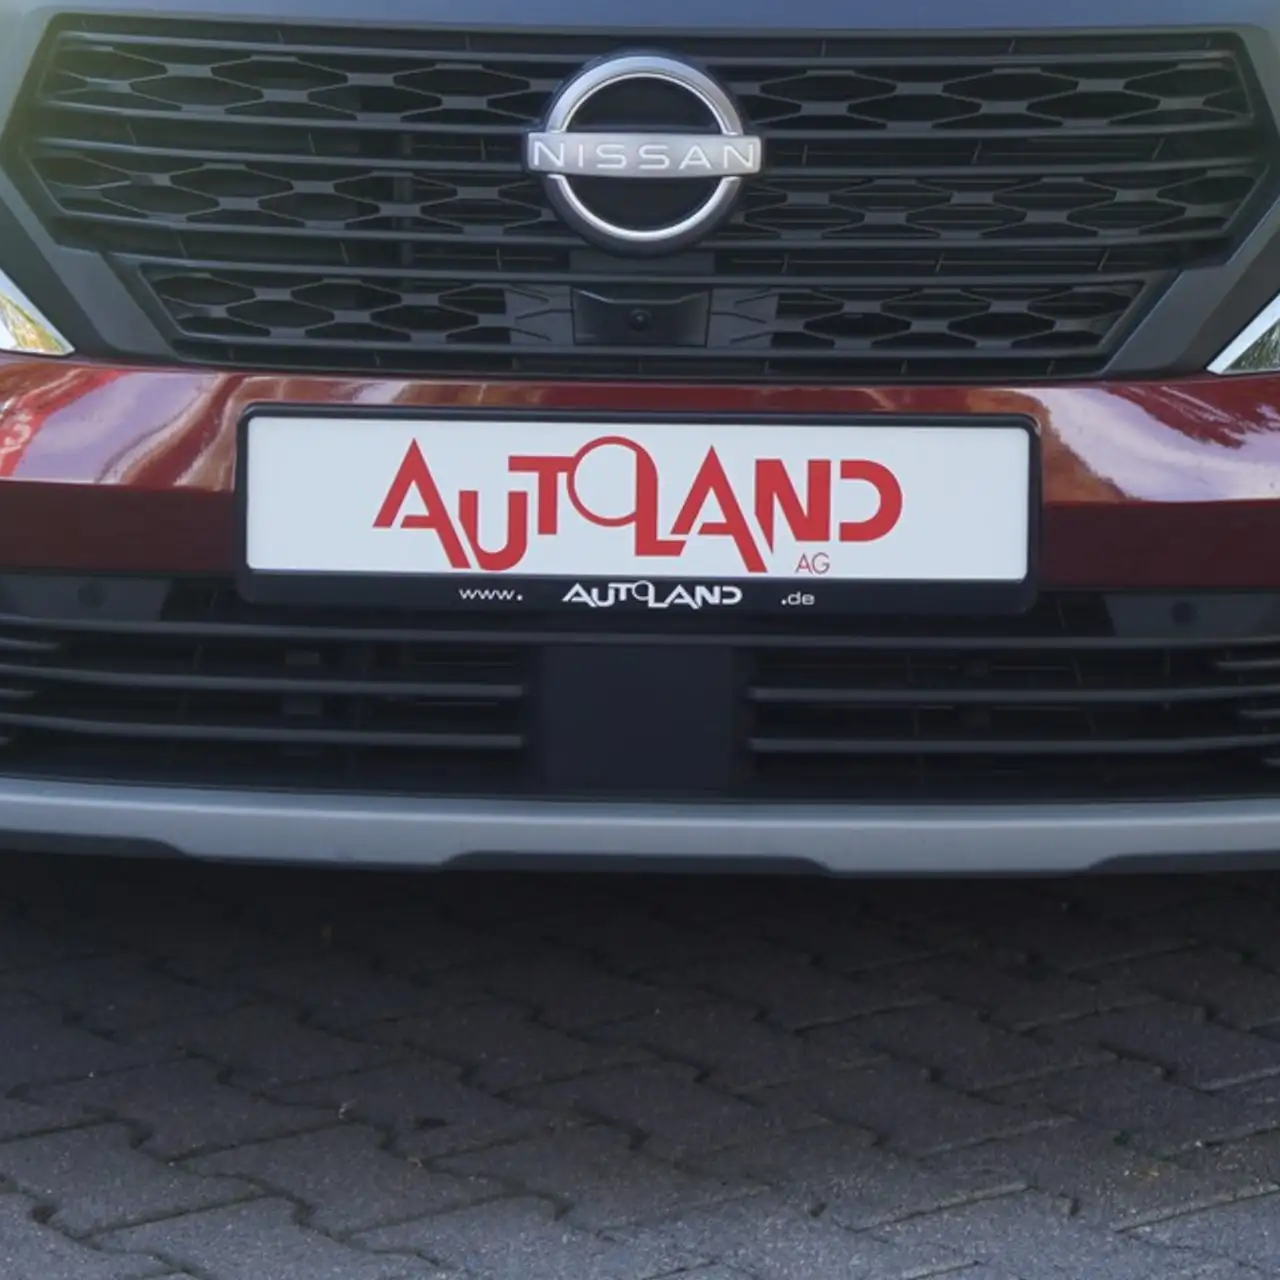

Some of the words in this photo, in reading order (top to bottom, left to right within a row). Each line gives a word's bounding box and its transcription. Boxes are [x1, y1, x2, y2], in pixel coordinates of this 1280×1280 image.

[532, 140, 755, 170] NISSAN
[373, 436, 903, 573] AUTOLAND
[795, 552, 831, 574] AG
[458, 587, 524, 601] www.
[561, 580, 744, 609] AUTOLAND
[780, 590, 816, 607] .de
